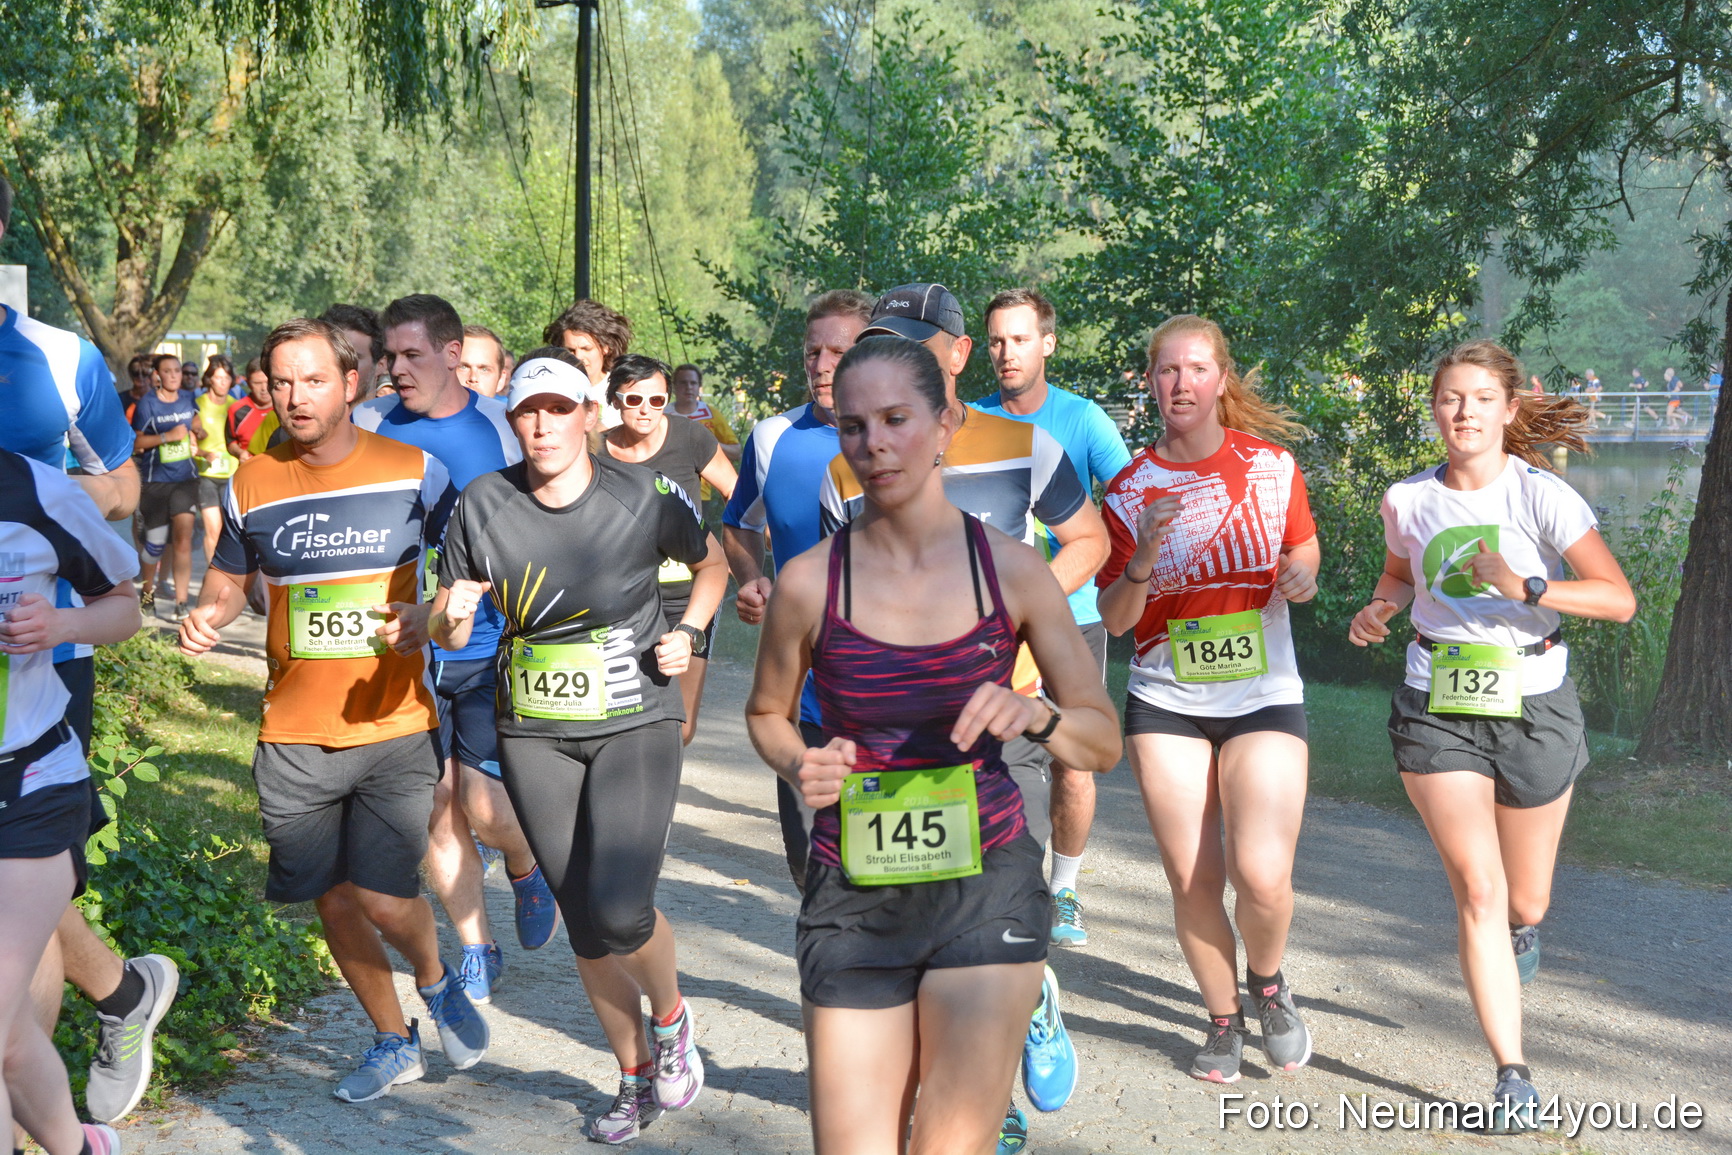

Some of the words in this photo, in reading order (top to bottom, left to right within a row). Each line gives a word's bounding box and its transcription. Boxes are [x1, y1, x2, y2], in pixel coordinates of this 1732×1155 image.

[290, 526, 392, 551] Fischer
[300, 545, 386, 560] AUTOMOBILE
[308, 610, 364, 638] 563
[1183, 635, 1253, 664] 1843
[1199, 663, 1217, 671] Götz
[1217, 661, 1242, 670] Marina
[519, 669, 590, 699] 1429
[1448, 668, 1500, 696] 132
[527, 696, 562, 708] Kürzinger
[563, 699, 583, 707] Julia
[1441, 693, 1478, 702] Federhofer
[1480, 695, 1505, 704] Carina
[867, 809, 947, 852] 145
[865, 853, 897, 865] Strobl
[899, 849, 952, 863] Elisabeth
[883, 863, 920, 873] Bionorica
[921, 862, 932, 871] SE
